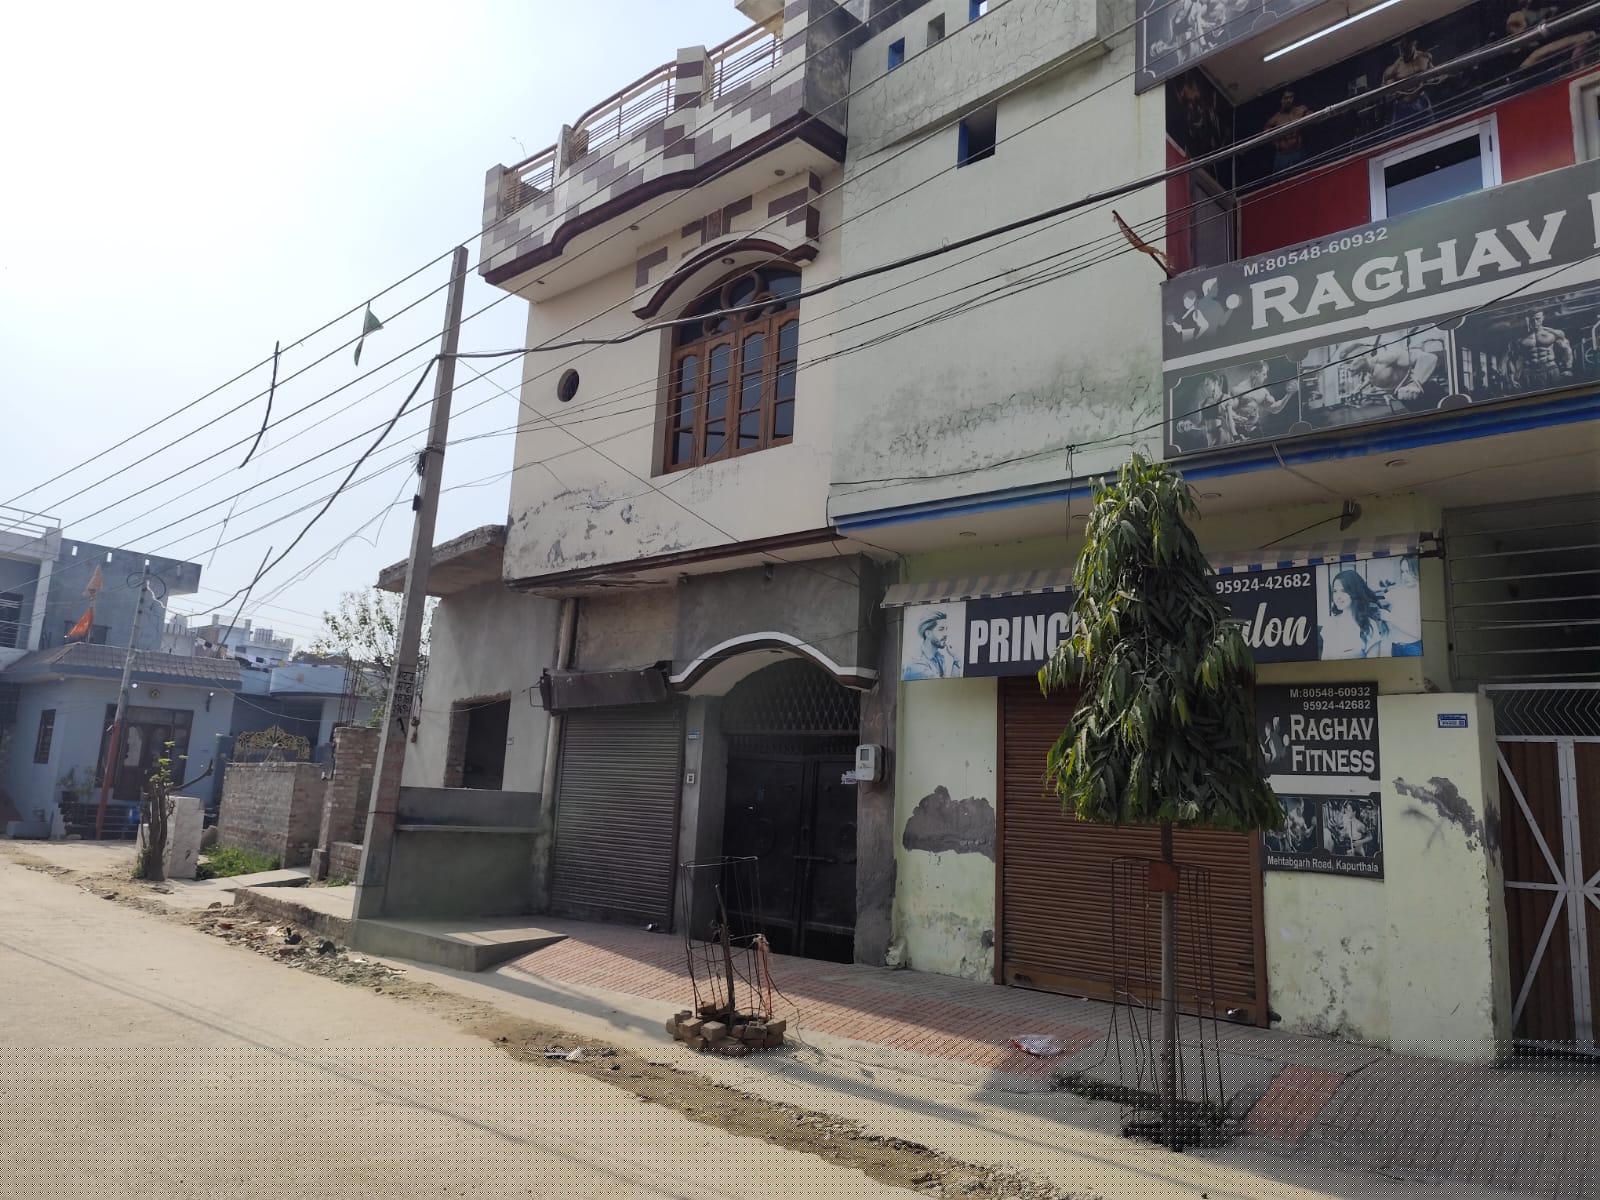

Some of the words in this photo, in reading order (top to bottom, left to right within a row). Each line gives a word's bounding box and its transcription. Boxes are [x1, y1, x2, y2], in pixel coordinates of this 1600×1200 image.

[1243, 227, 1388, 277] M:80548-60932
[1250, 209, 1567, 330] RAGHAV
[1215, 573, 1311, 594] 95924-42682
[1214, 602, 1311, 649] lon
[1289, 687, 1371, 699] M:80548-60932
[1303, 700, 1371, 711] 95924-42682
[1290, 714, 1374, 741] RAGHAV
[1291, 745, 1375, 773] FITNESS
[1267, 855, 1310, 869] Mehtabgarh
[1312, 858, 1334, 871] Road,
[1336, 859, 1379, 873] Kapurthala
